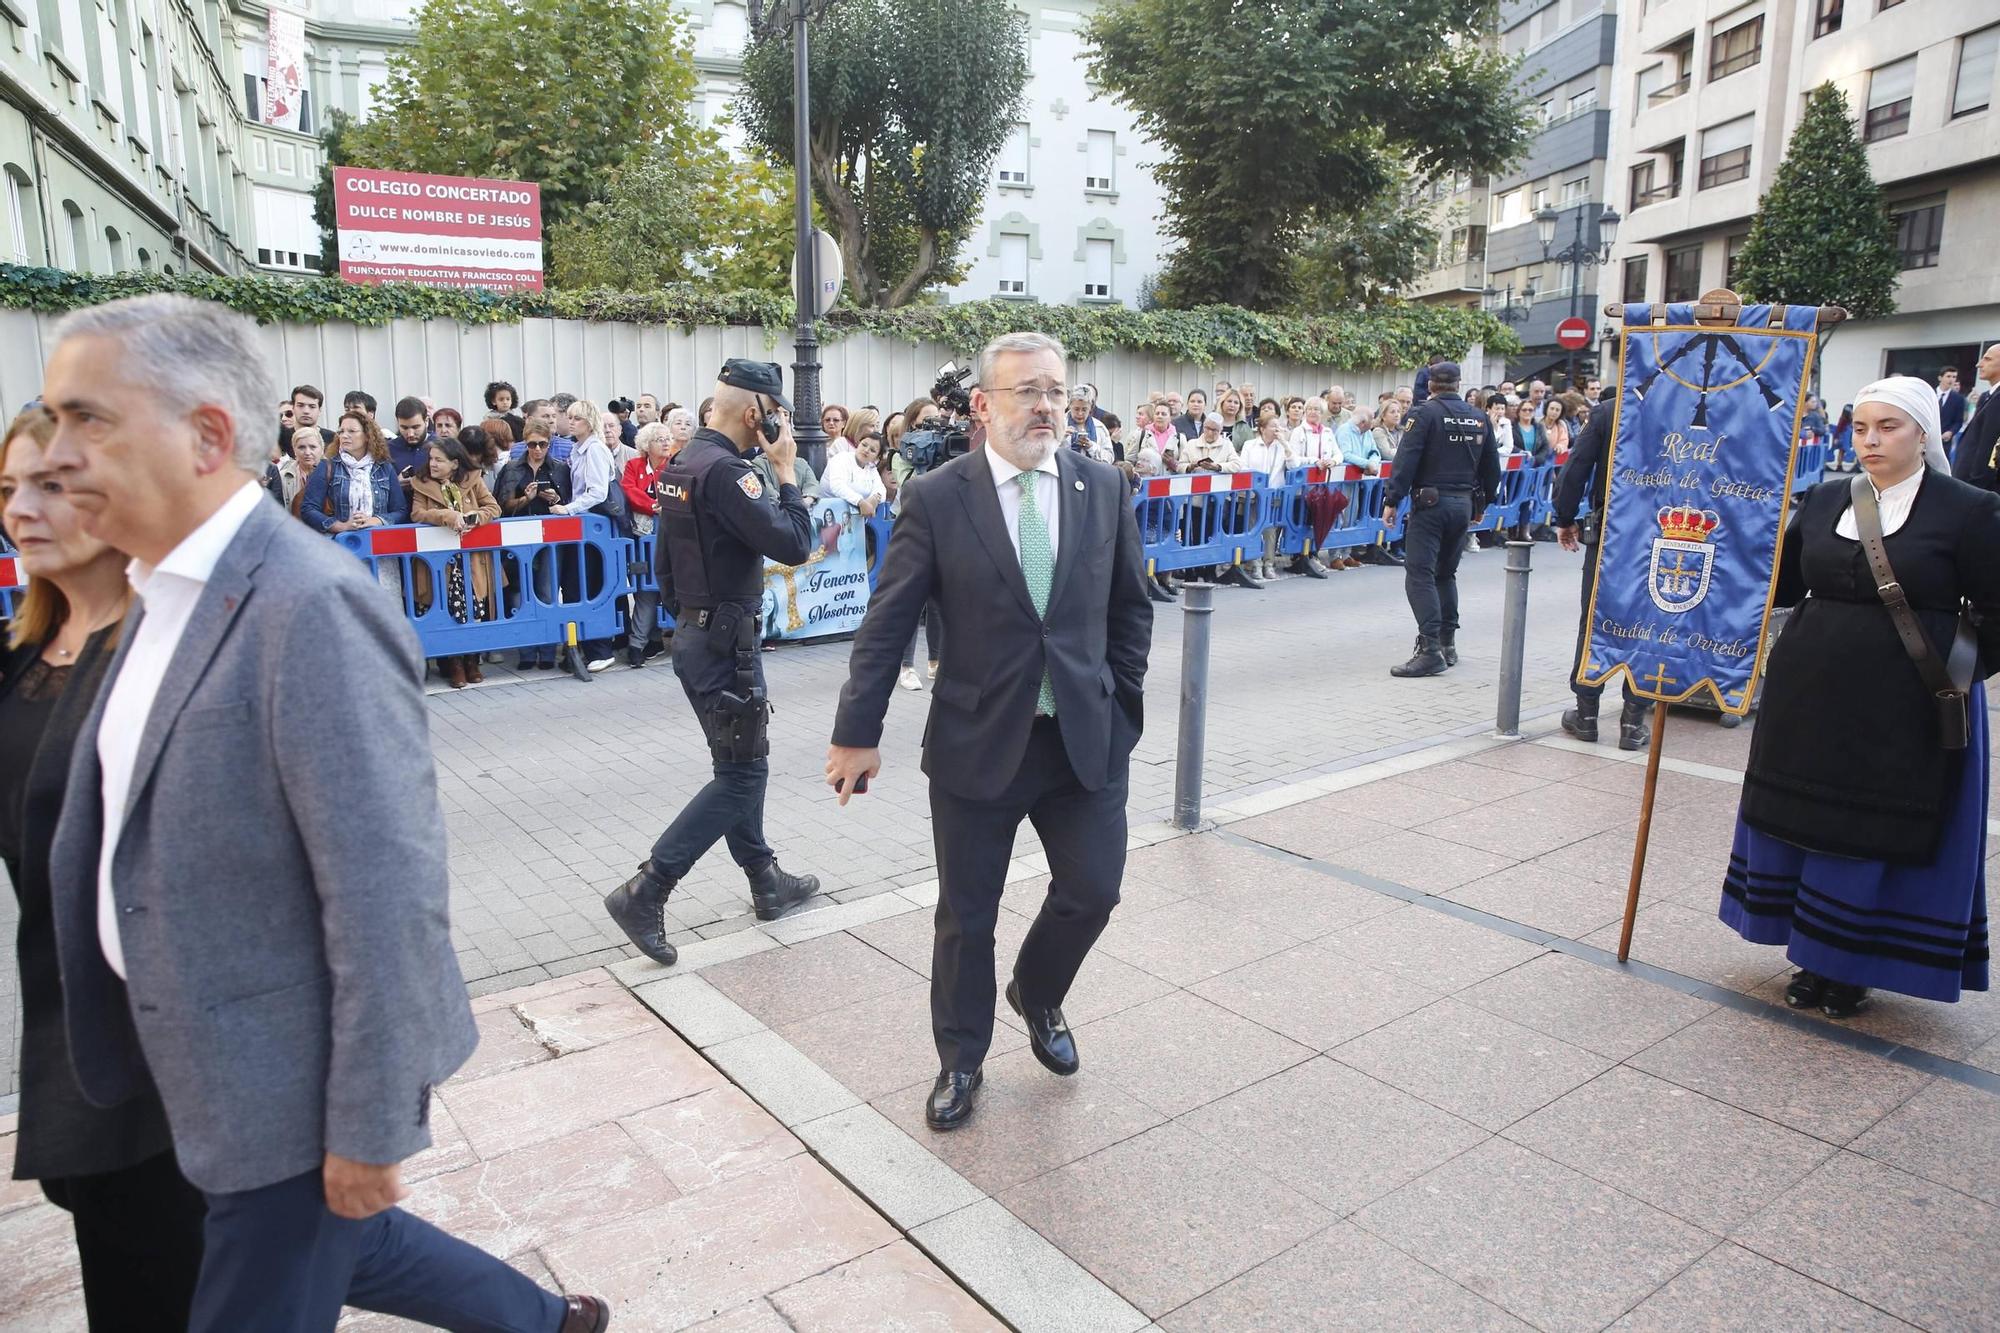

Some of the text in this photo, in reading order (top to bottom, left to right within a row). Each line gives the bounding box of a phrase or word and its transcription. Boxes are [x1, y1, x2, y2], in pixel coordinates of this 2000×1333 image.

[347, 178, 531, 205] COLEGIO CONCERTADO
[349, 205, 531, 228] DULCE NOMBRE DE JESÚS
[380, 243, 535, 260] www.dominicasoviedo.com
[348, 265, 537, 282] FUNDACIÓN EDUCATIVA FRANCISCO COLL
[1657, 432, 1727, 464] Real
[1621, 466, 1672, 487] Banda
[1680, 469, 1700, 489] de
[834, 590, 855, 602] con
[1602, 619, 1655, 641] Ciudad
[1659, 626, 1678, 645] de
[1687, 632, 1747, 658] Oviedo
